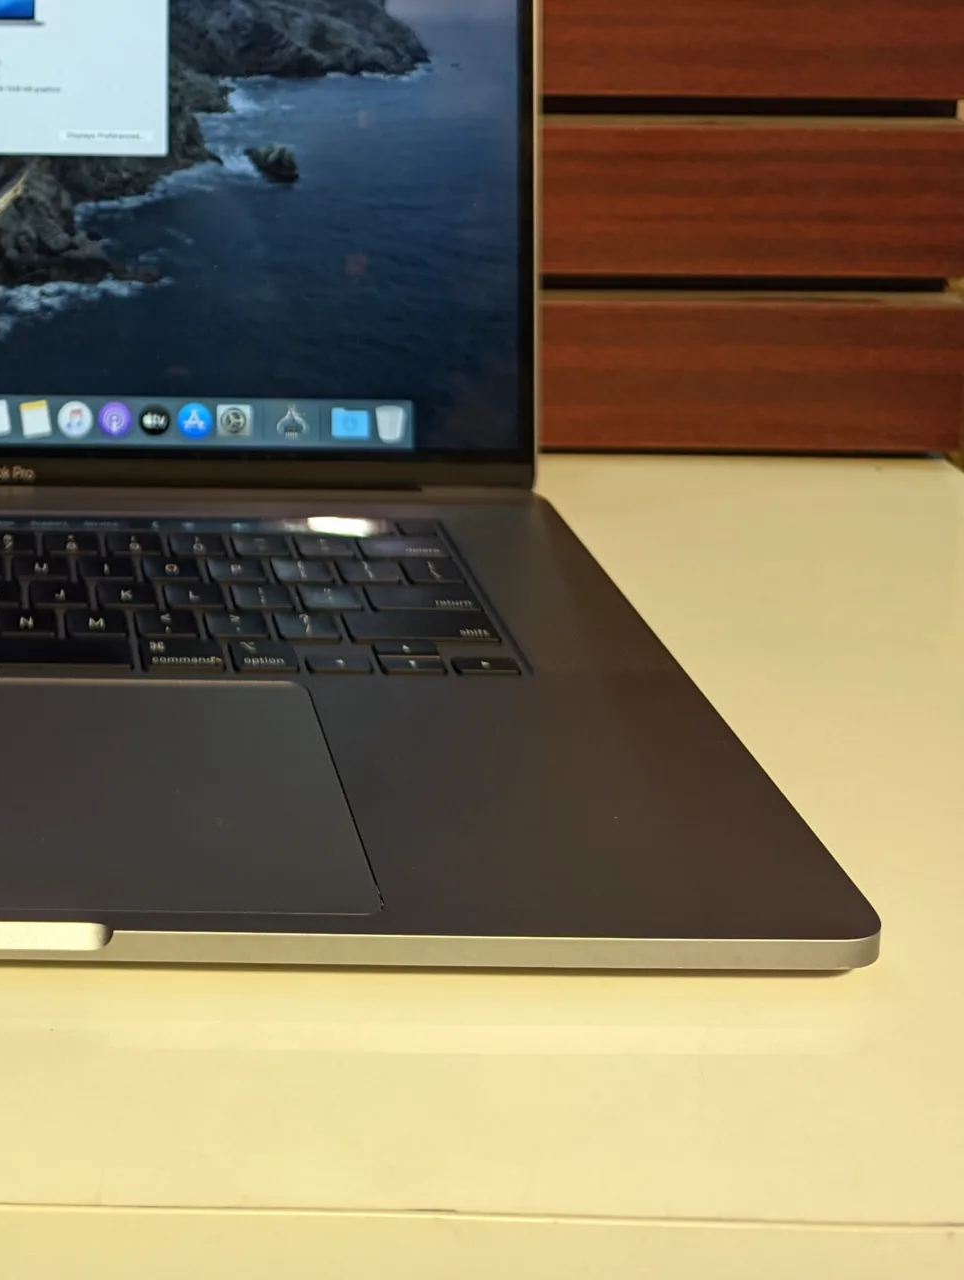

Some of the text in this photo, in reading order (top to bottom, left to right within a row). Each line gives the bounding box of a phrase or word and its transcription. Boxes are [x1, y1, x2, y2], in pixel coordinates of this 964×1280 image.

[13, 466, 35, 479] Pro
[151, 655, 216, 664] command
[243, 654, 286, 667] option
